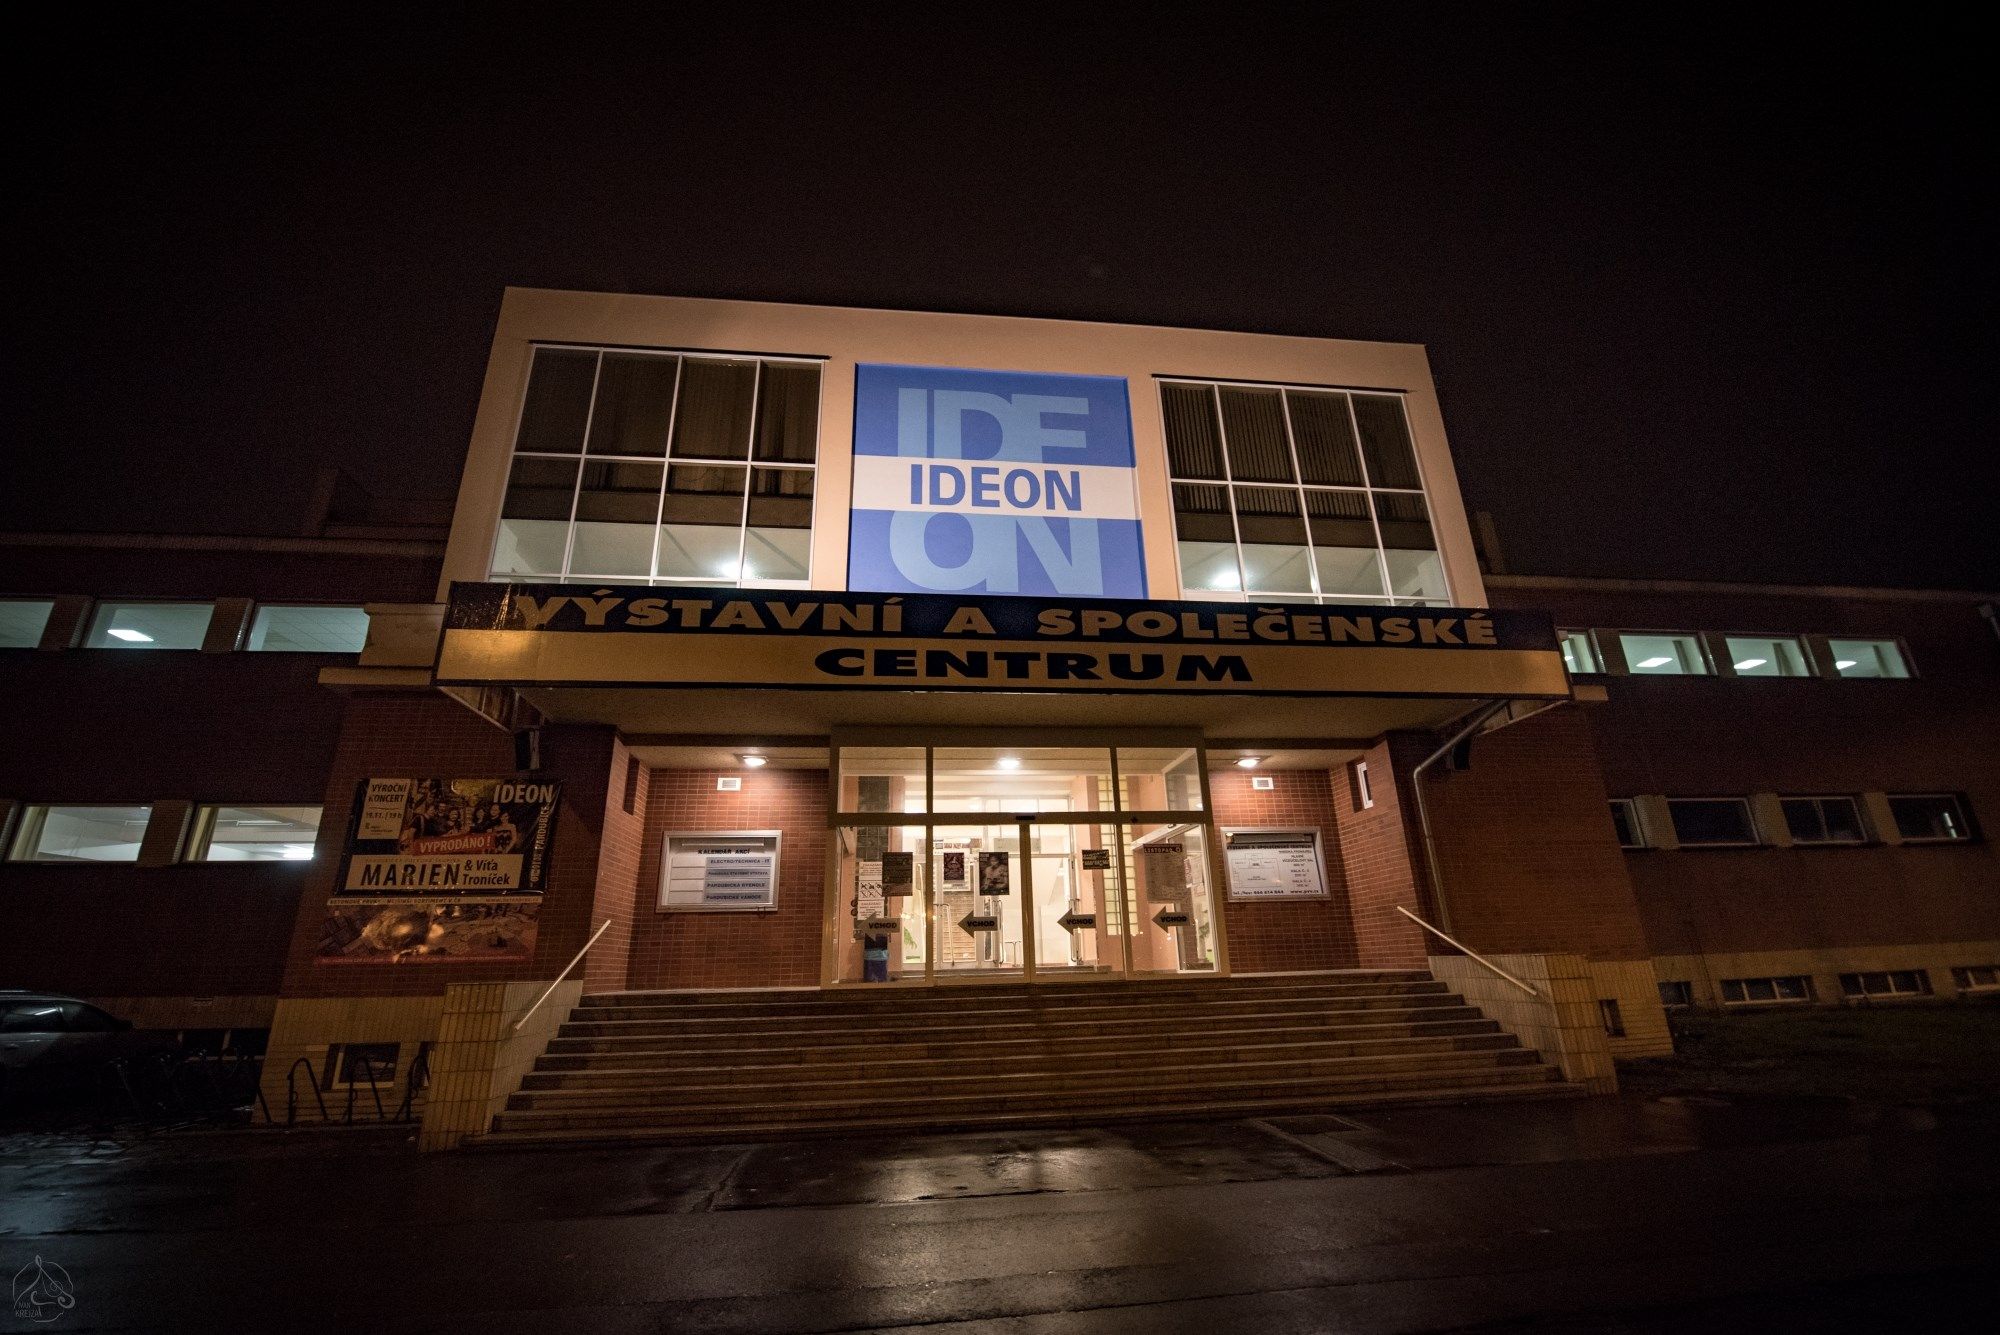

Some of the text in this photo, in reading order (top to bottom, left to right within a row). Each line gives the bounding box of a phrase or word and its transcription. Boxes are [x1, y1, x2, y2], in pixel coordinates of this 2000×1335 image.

[910, 463, 1082, 511] IDEON
[514, 589, 1498, 646] VÝSTAVNÍ A SPOLEČENSKÉ
[814, 647, 1254, 684] CENTRUM
[493, 784, 554, 803] IDEON
[360, 863, 462, 886] MARIEN
[464, 859, 474, 871] &
[475, 859, 498, 871] Víťa
[462, 872, 510, 886] Troníček
